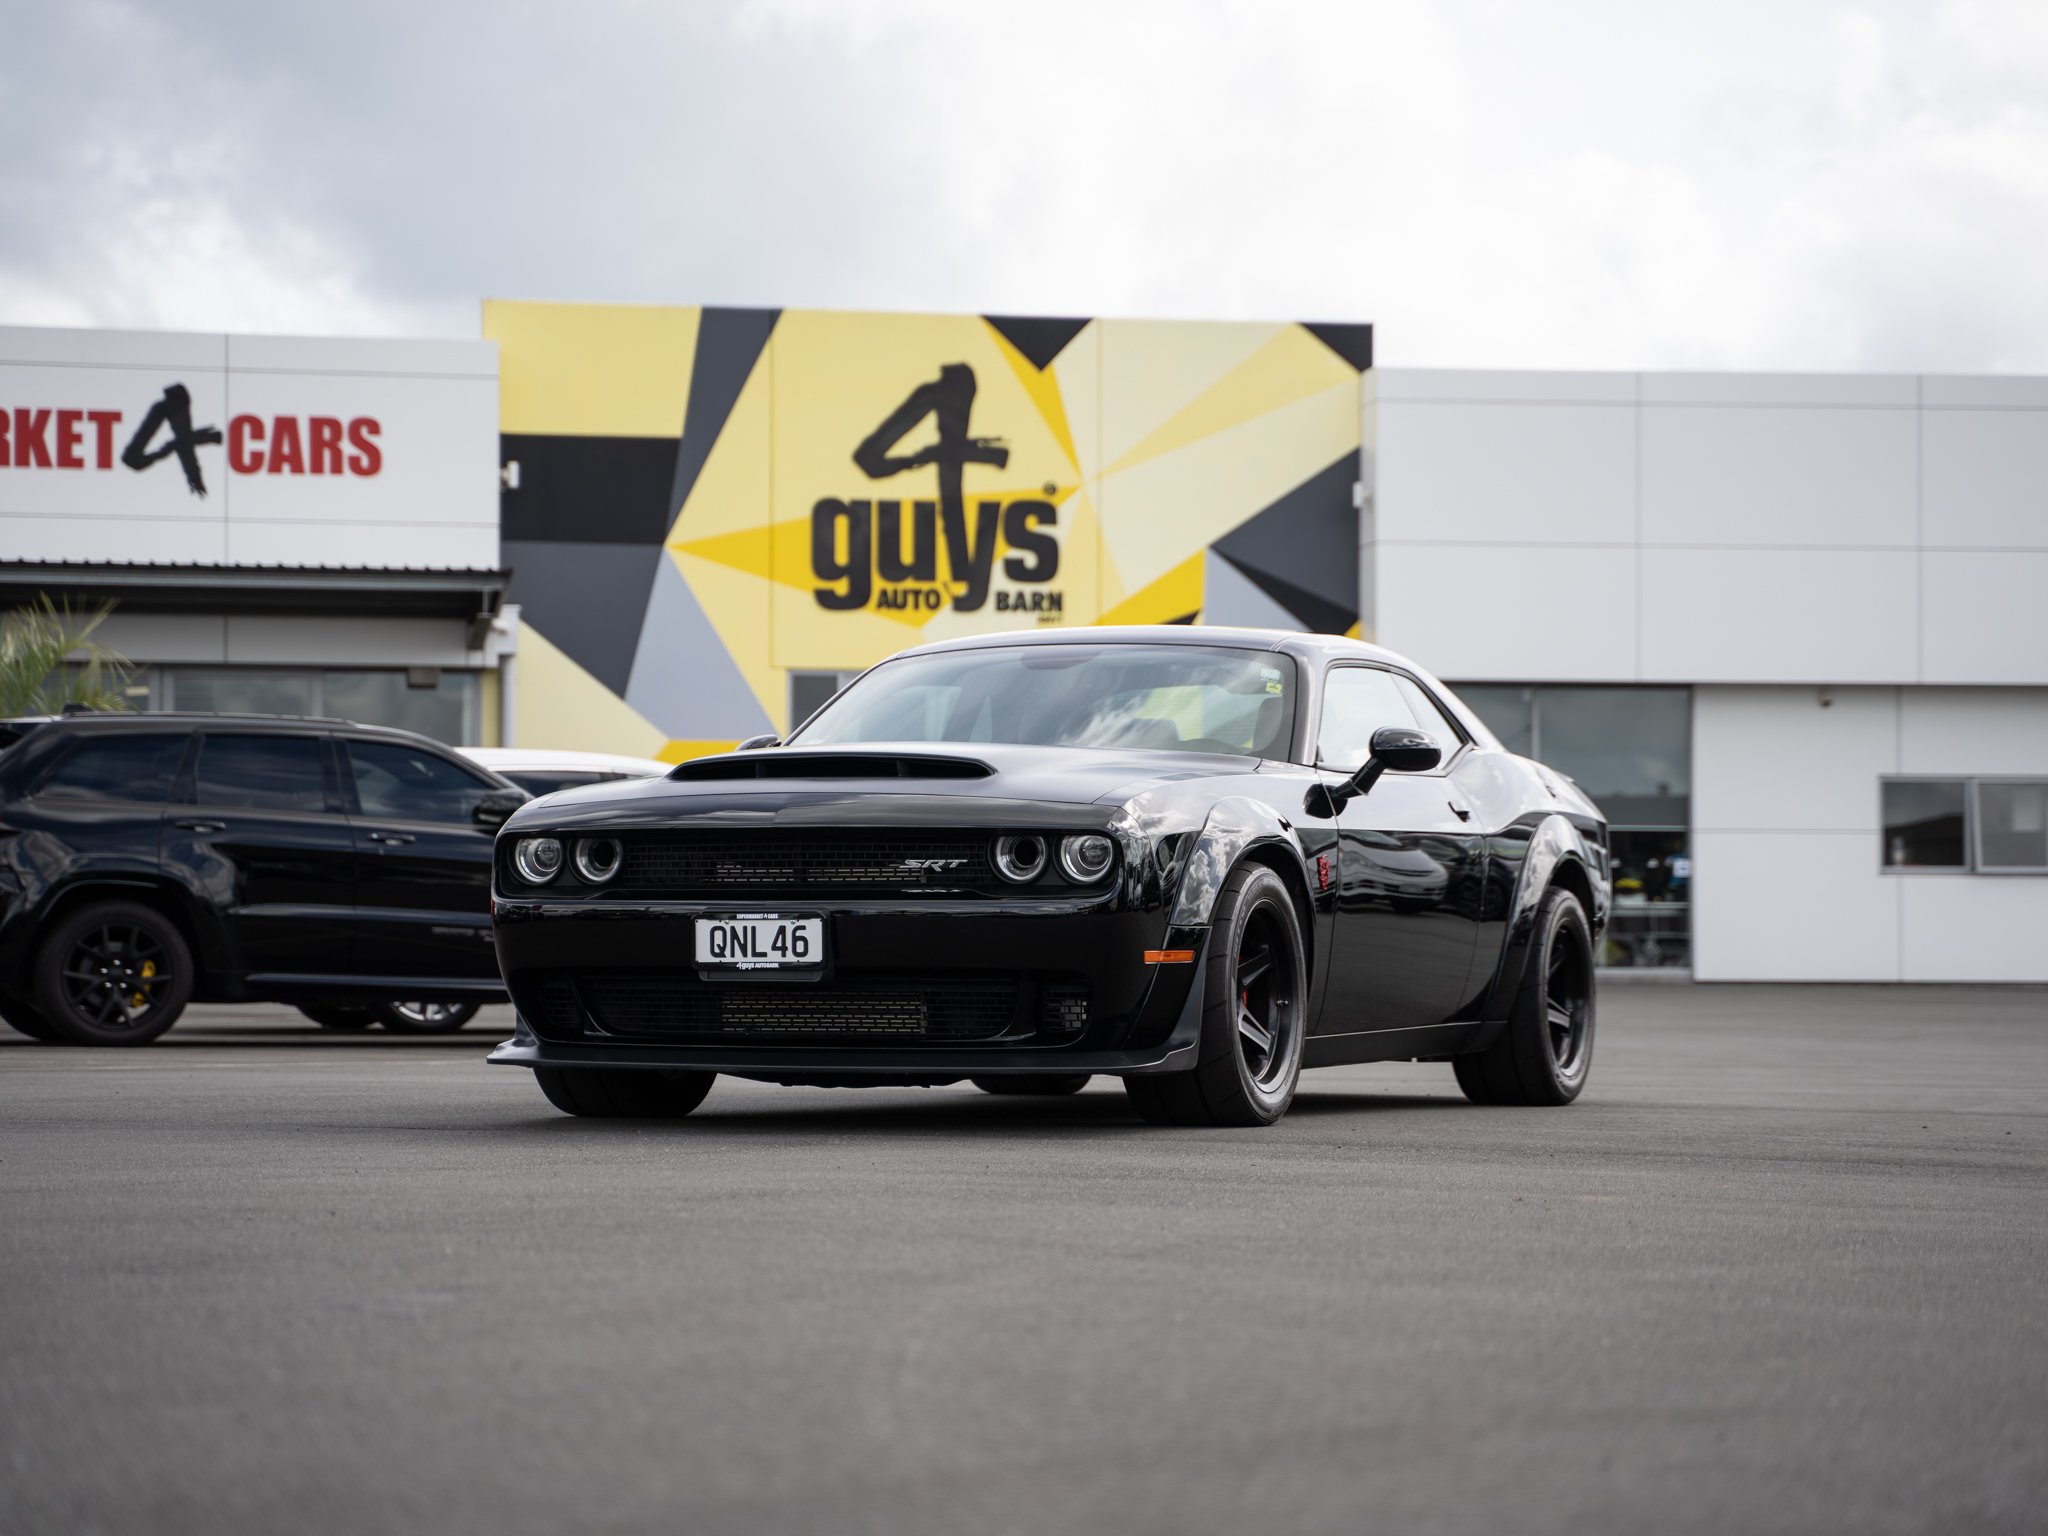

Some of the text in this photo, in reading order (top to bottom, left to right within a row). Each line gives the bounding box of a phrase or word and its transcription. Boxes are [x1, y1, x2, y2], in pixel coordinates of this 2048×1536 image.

[121, 382, 223, 498] 4
[227, 413, 382, 477] CARS
[853, 361, 1010, 500] 4
[811, 497, 1060, 613] guys
[876, 588, 1063, 612] AUTO BARN
[899, 859, 969, 872] SRT
[709, 925, 809, 958] QNL46
